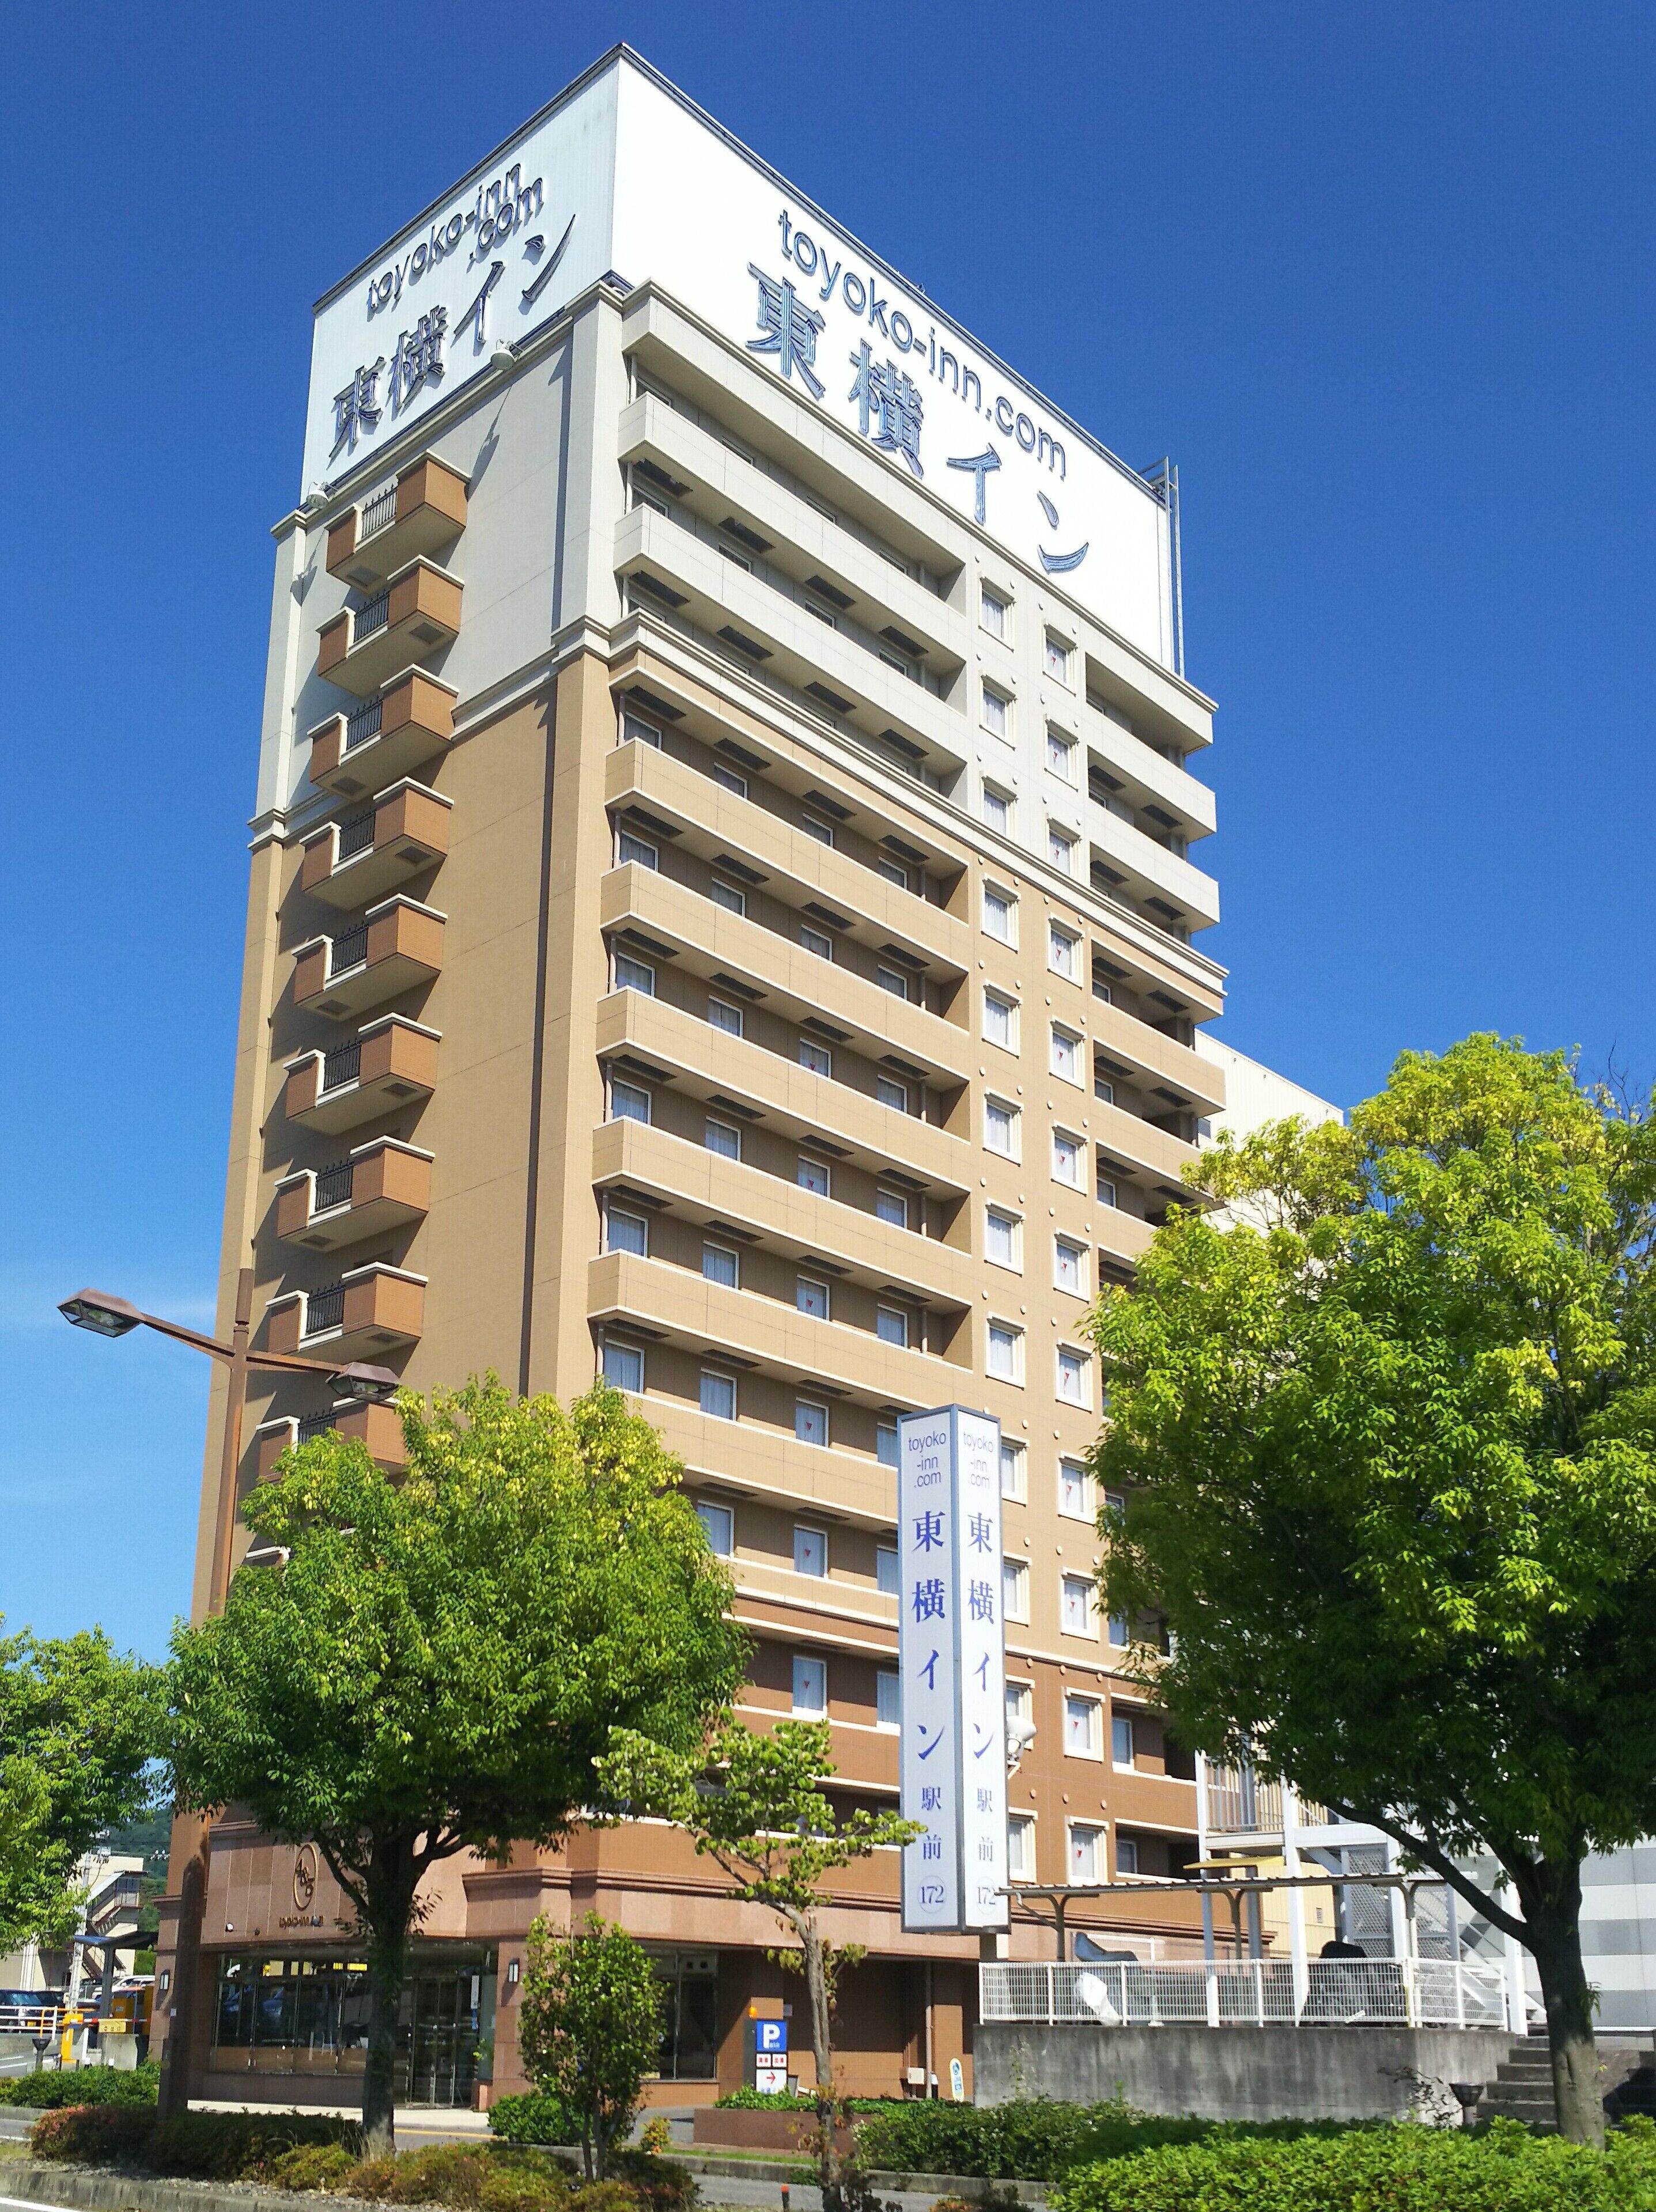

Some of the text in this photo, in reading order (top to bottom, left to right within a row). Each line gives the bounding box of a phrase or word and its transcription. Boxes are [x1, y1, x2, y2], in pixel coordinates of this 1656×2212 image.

[468, 177, 545, 261] .com
[368, 163, 522, 309] toyoko-inn
[329, 213, 576, 459] 東横イン
[778, 210, 1066, 480] toyoko-inn.com
[746, 262, 1089, 574] 東横イン
[908, 1431, 946, 1453] toyoko
[963, 1431, 994, 1453] toyoko
[917, 1456, 939, 1471] -inn
[914, 1471, 942, 1488] .com
[921, 1884, 944, 1904] 172
[977, 1886, 996, 1904] 172
[763, 2023, 781, 2049] P
